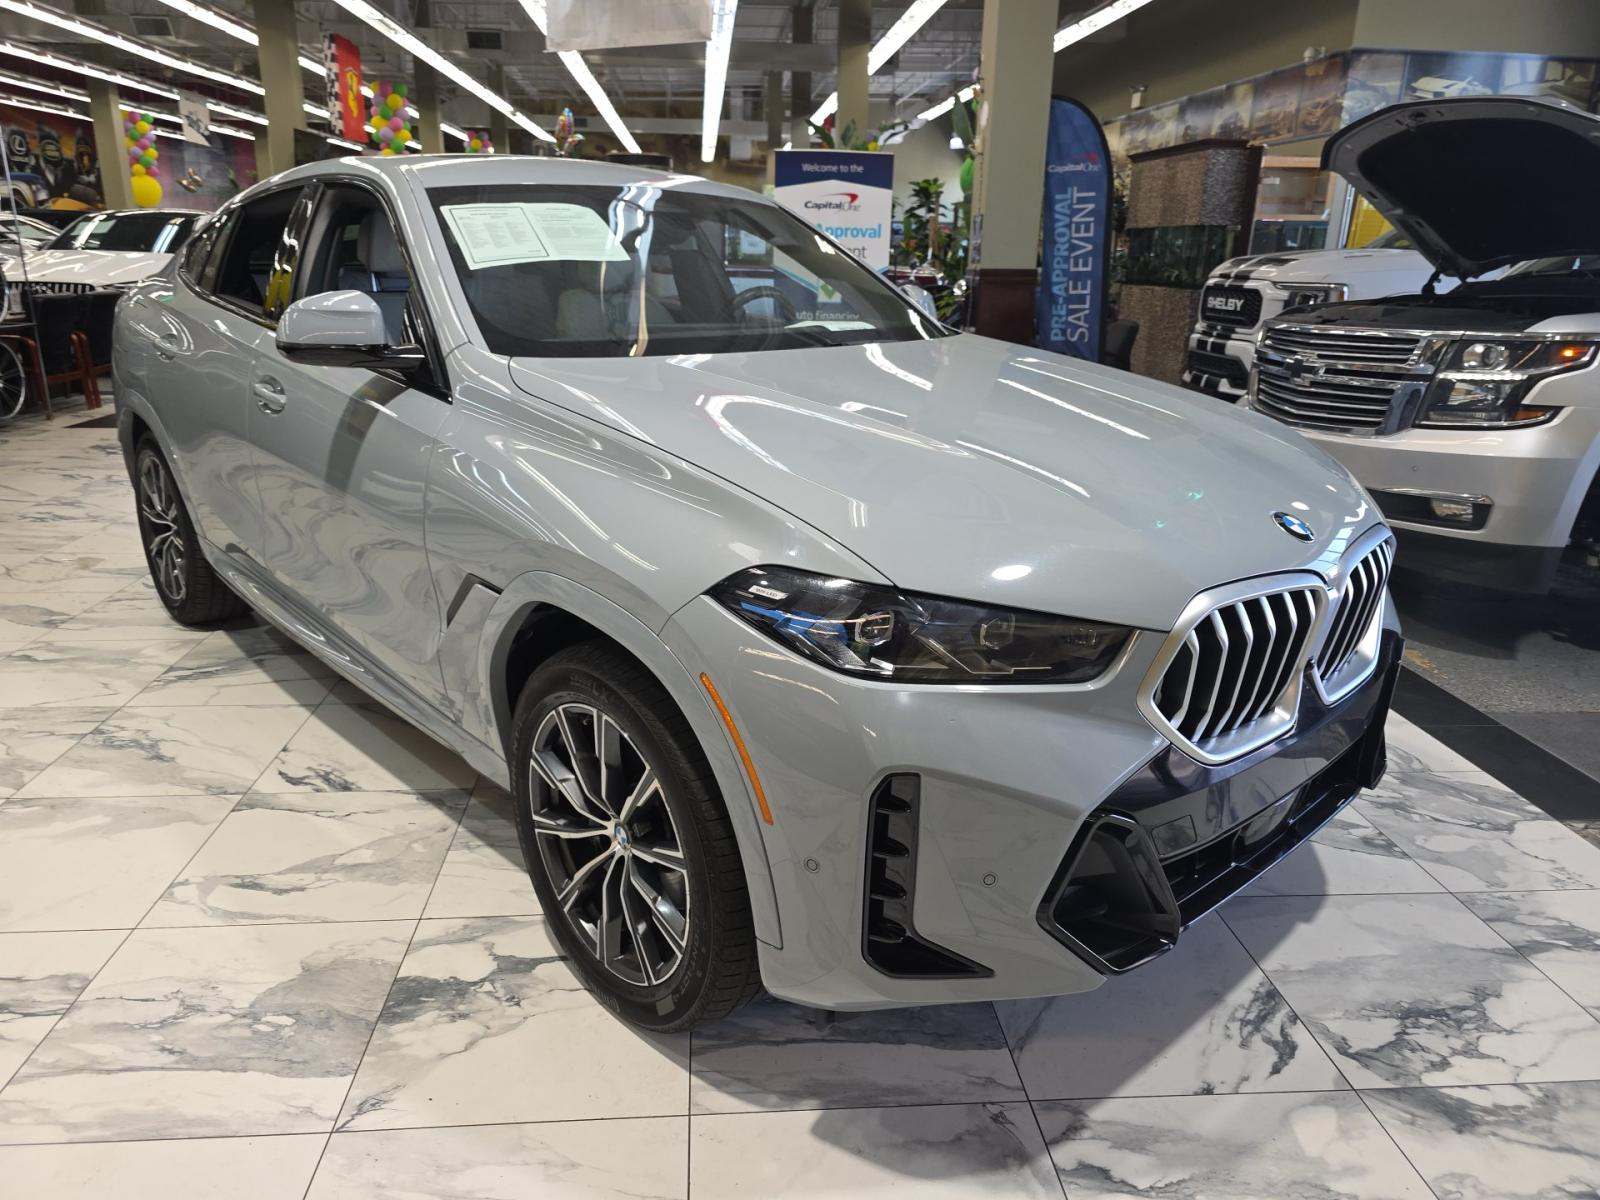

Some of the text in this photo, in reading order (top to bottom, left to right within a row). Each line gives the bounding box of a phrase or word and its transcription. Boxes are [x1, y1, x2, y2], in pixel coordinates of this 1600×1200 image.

[801, 163, 864, 174] Welcome to the
[1050, 186, 1073, 342] PRE-APPROVAL
[1066, 186, 1097, 343] SALE EVENT
[1207, 296, 1244, 311] SHELBY
[796, 309, 814, 321] uto
